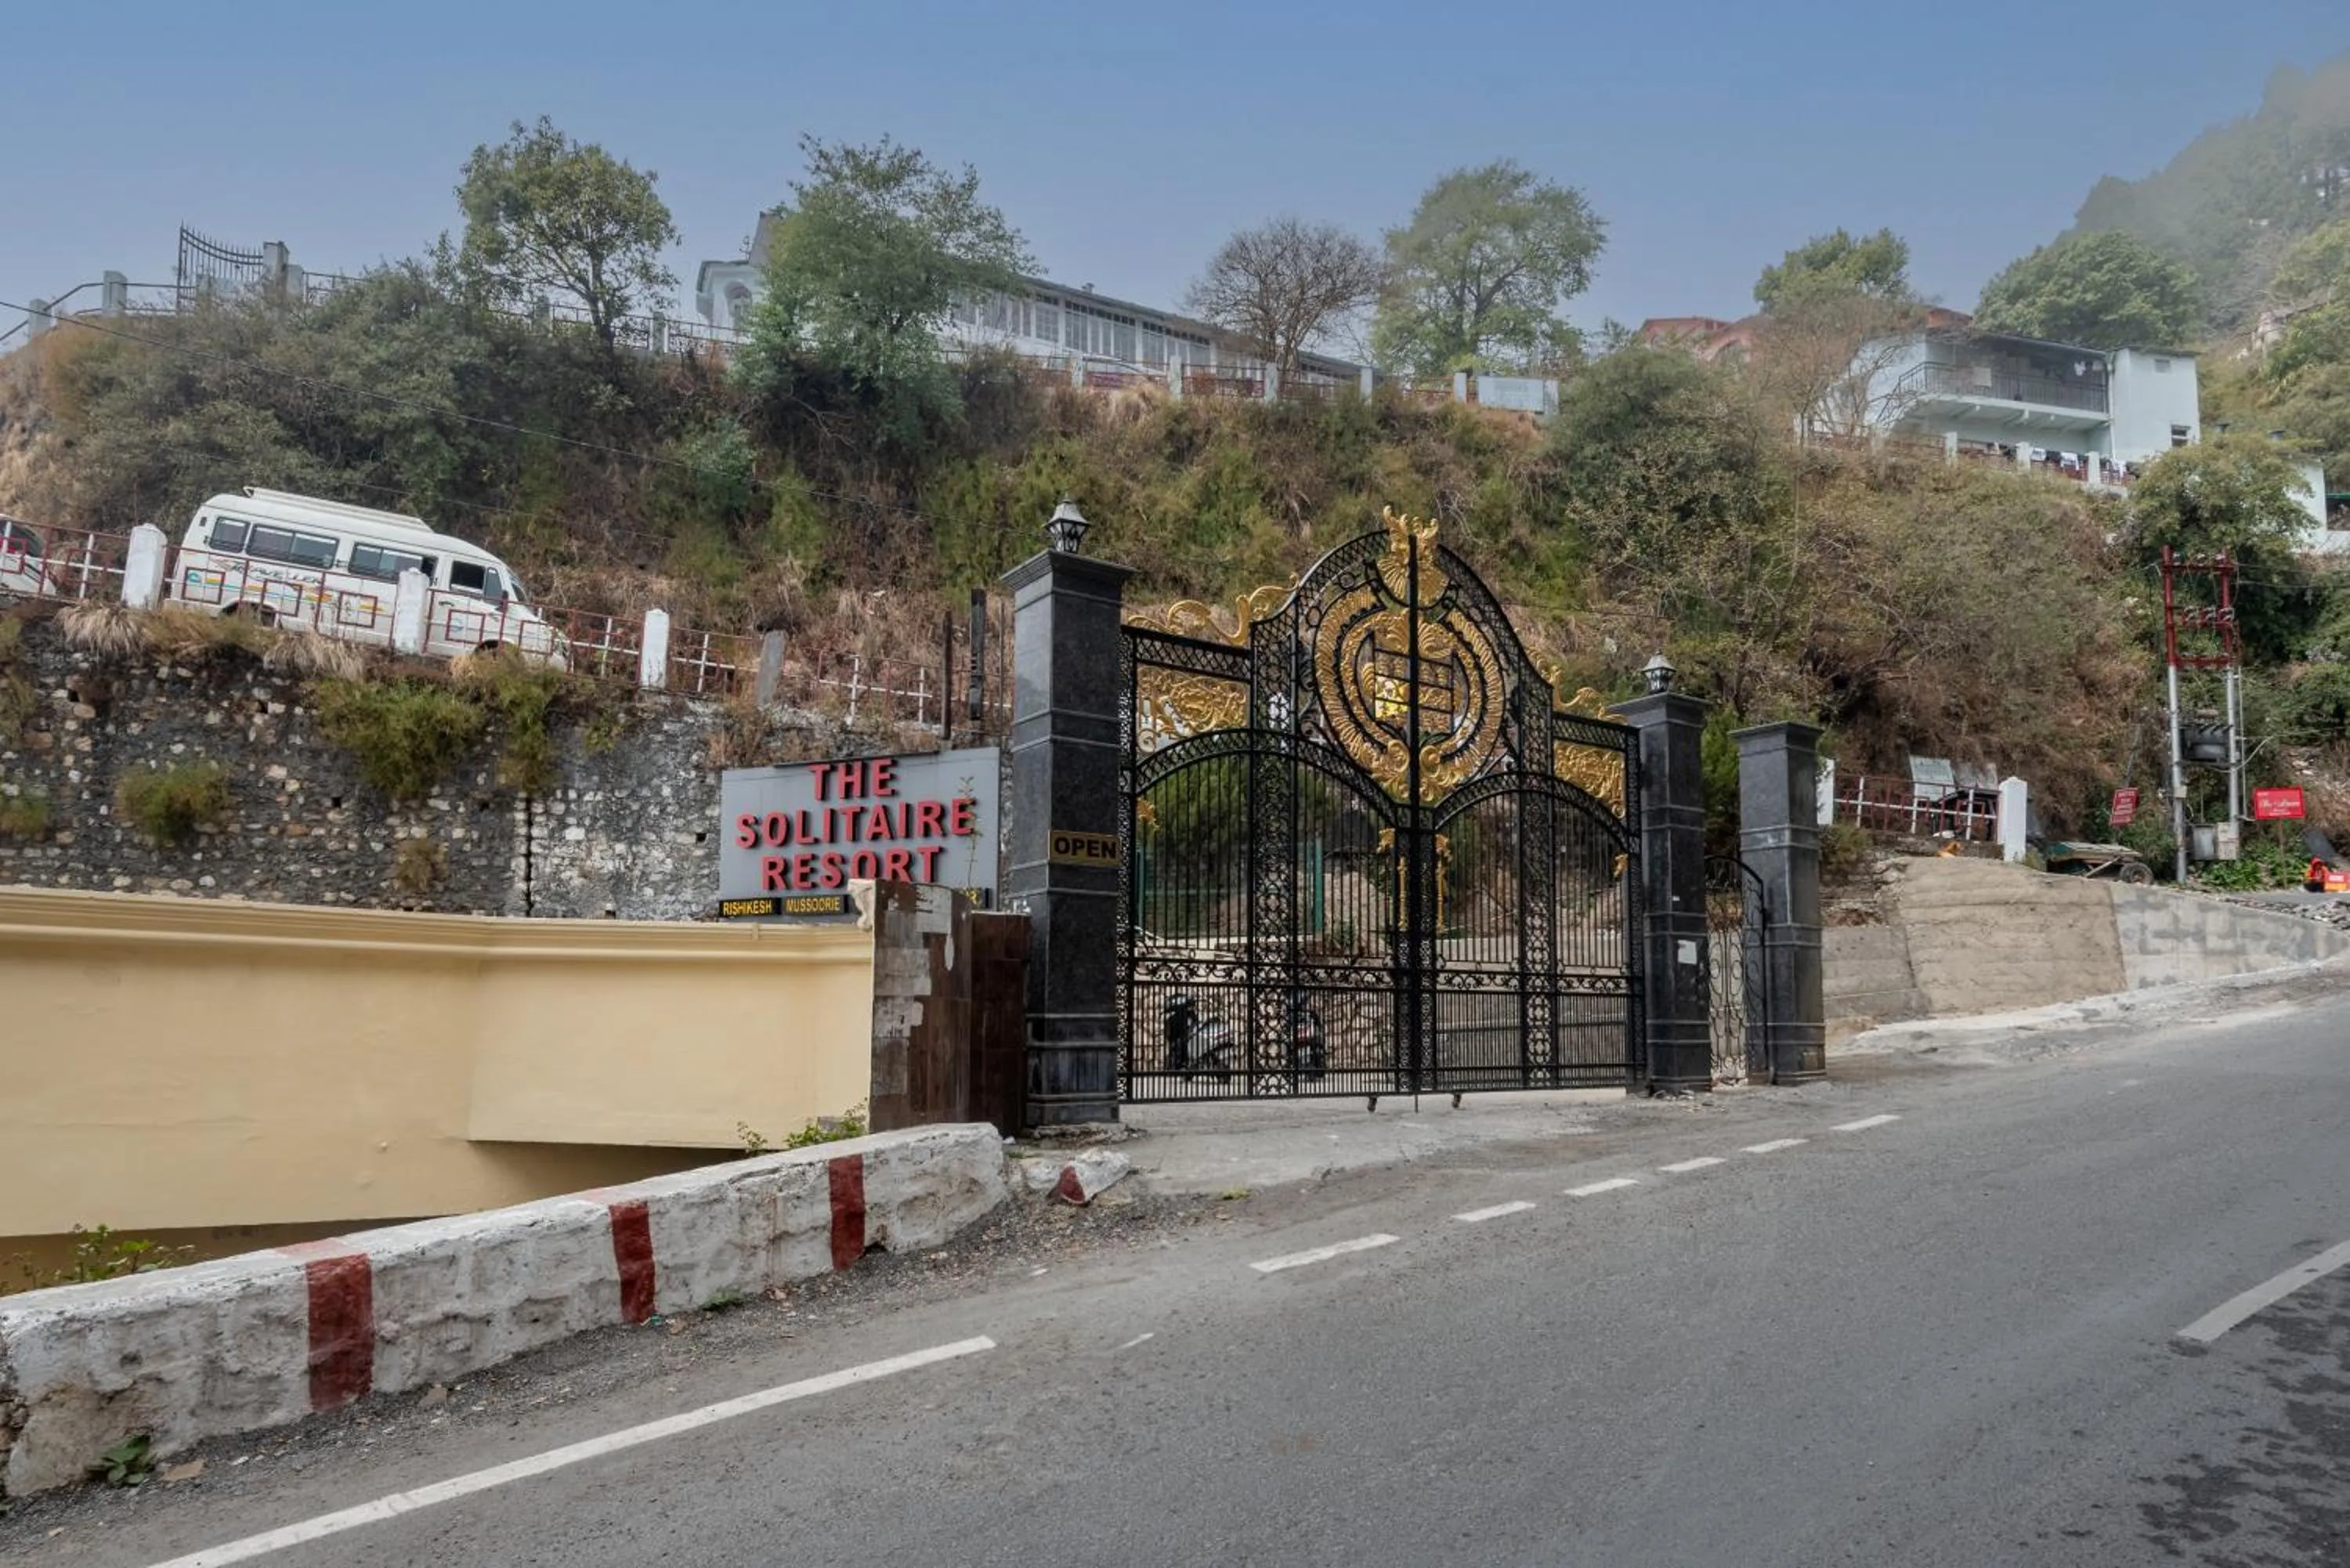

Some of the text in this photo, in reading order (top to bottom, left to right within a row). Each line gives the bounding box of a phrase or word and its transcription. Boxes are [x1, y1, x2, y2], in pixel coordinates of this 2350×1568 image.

[809, 758, 895, 800] THE
[736, 797, 975, 848] SOLITAIRE
[761, 846, 942, 890] RESORT
[1054, 836, 1116, 859] OPEN
[723, 901, 772, 915] RISHIKESH
